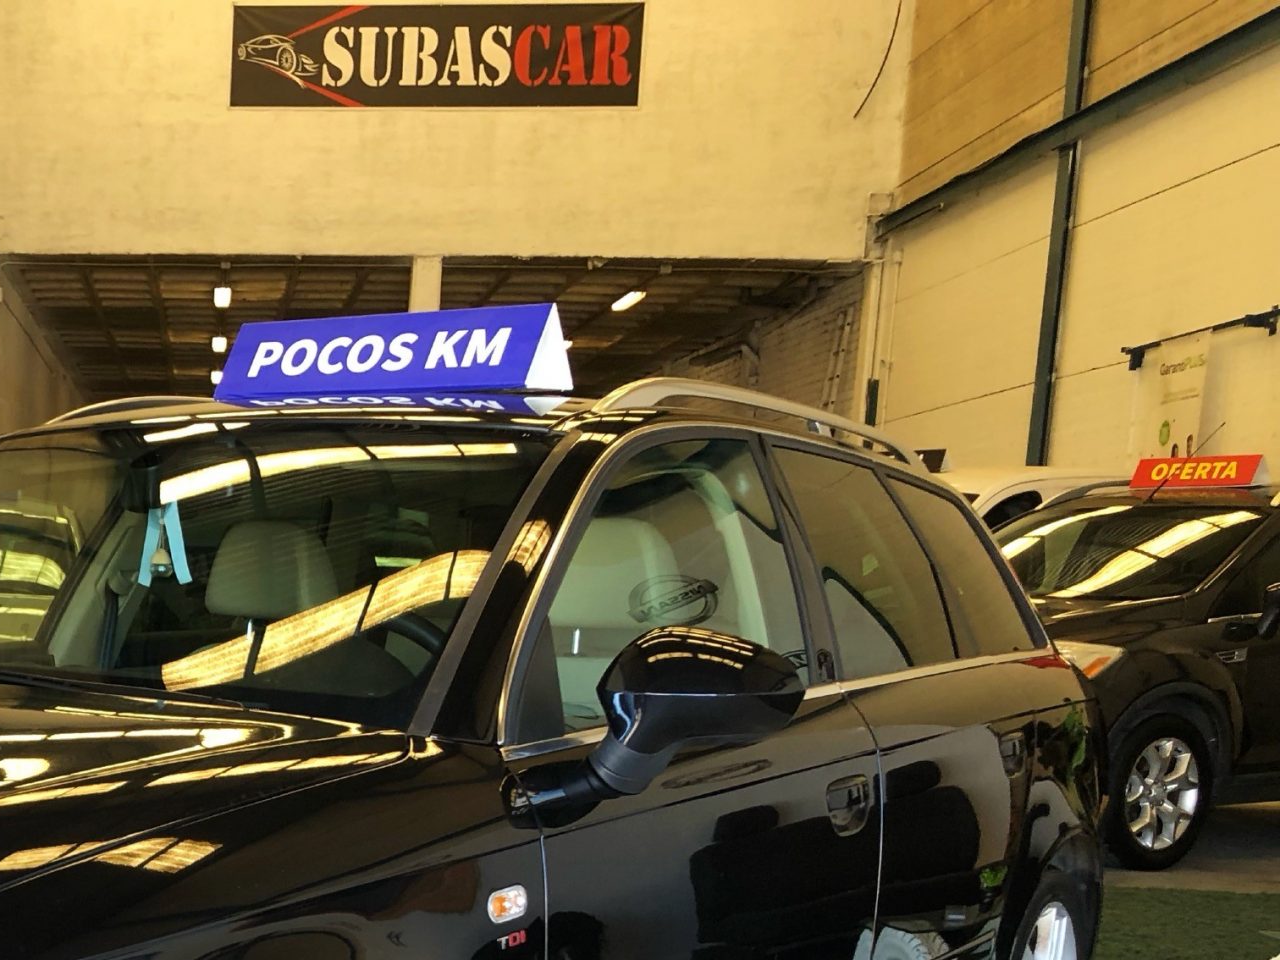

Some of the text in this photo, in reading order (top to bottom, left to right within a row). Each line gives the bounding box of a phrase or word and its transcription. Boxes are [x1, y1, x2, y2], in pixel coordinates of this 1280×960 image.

[321, 24, 632, 88] SUBASCAR
[247, 327, 512, 379] POCOS KM
[1150, 461, 1238, 481] OFERTA
[497, 930, 526, 951] TDI
